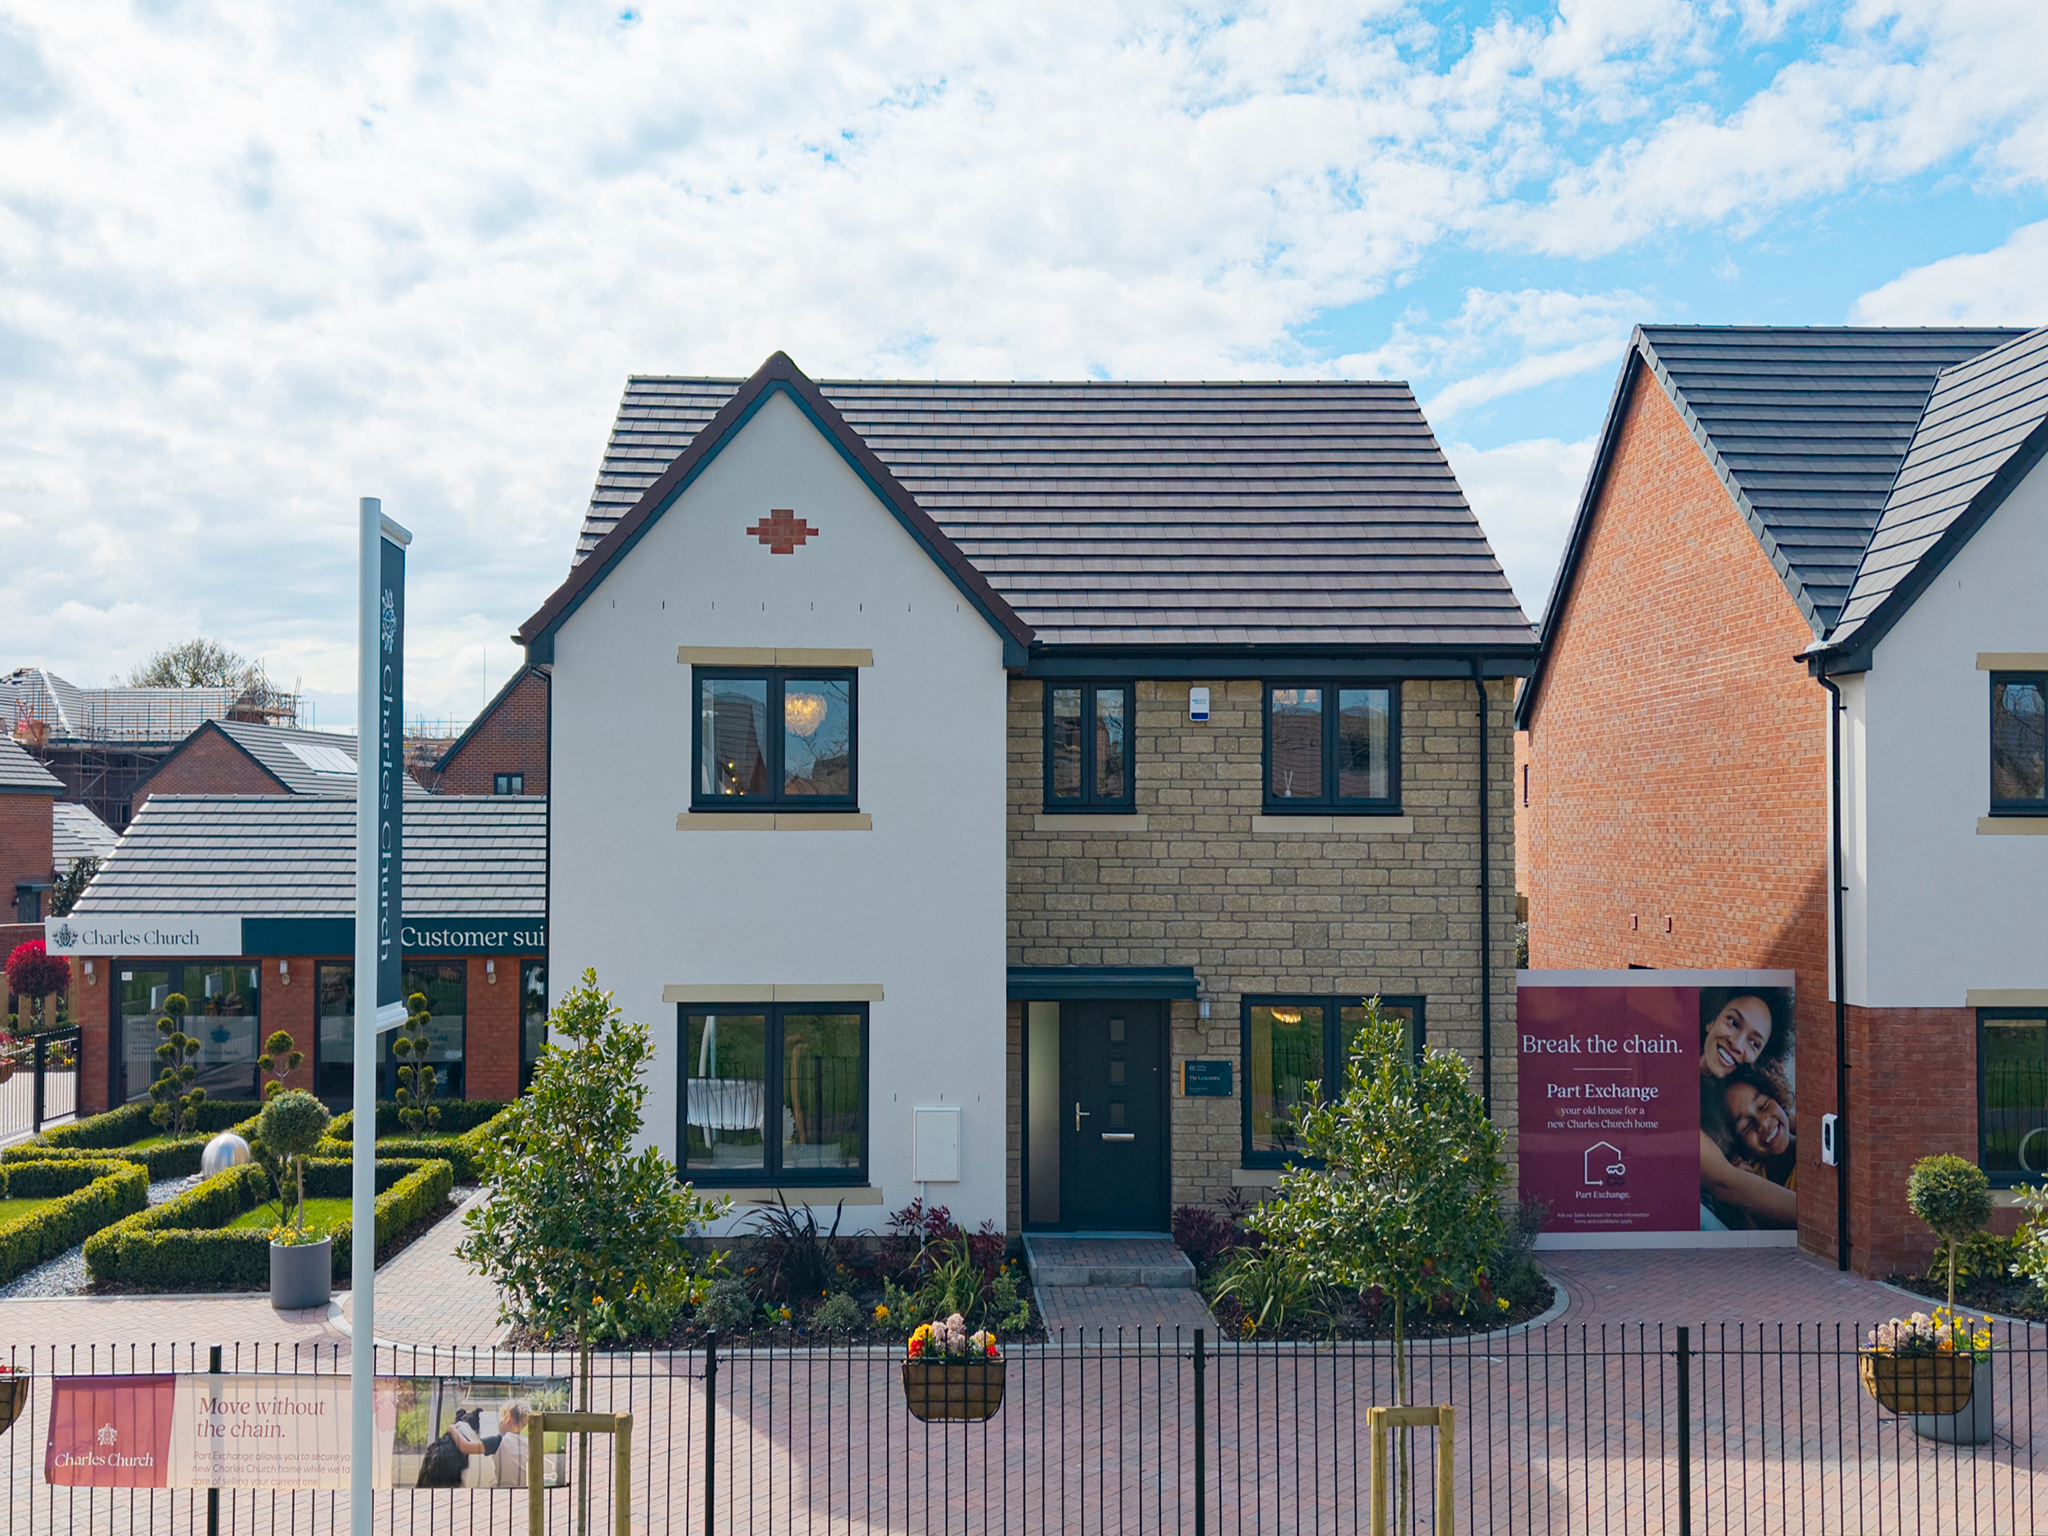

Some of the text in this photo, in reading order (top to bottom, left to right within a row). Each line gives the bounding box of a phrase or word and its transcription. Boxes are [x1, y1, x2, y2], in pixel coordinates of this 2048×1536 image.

[381, 664, 394, 962] Charles Church
[82, 929, 200, 945] Charles Church
[401, 926, 508, 947] Customer
[1522, 1034, 1683, 1053] Break the chain.
[1547, 1083, 1659, 1102] Part Exchange
[1560, 1108, 1581, 1117] your
[1582, 1106, 1596, 1115] old
[1597, 1106, 1623, 1115] house
[1624, 1106, 1638, 1115] for
[1547, 1119, 1659, 1129] new Charles Church home
[1575, 1190, 1631, 1200] Part Exchange.
[199, 1396, 325, 1416] Move without
[197, 1419, 286, 1438] the chain.
[55, 1451, 154, 1467] Charles Church
[193, 1451, 211, 1461] Part
[212, 1451, 254, 1462] Exchange
[255, 1451, 282, 1461] allows
[283, 1454, 299, 1463] you
[301, 1453, 310, 1461] to
[192, 1465, 211, 1473] new
[212, 1463, 245, 1473] Charles
[246, 1463, 277, 1473] Church
[278, 1464, 301, 1474] home
[303, 1464, 325, 1474] while
[327, 1466, 340, 1474] we
[191, 1477, 211, 1485] care
[212, 1475, 222, 1485] of
[222, 1476, 249, 1487] selling
[250, 1477, 269, 1488] your
[270, 1476, 301, 1486] current
